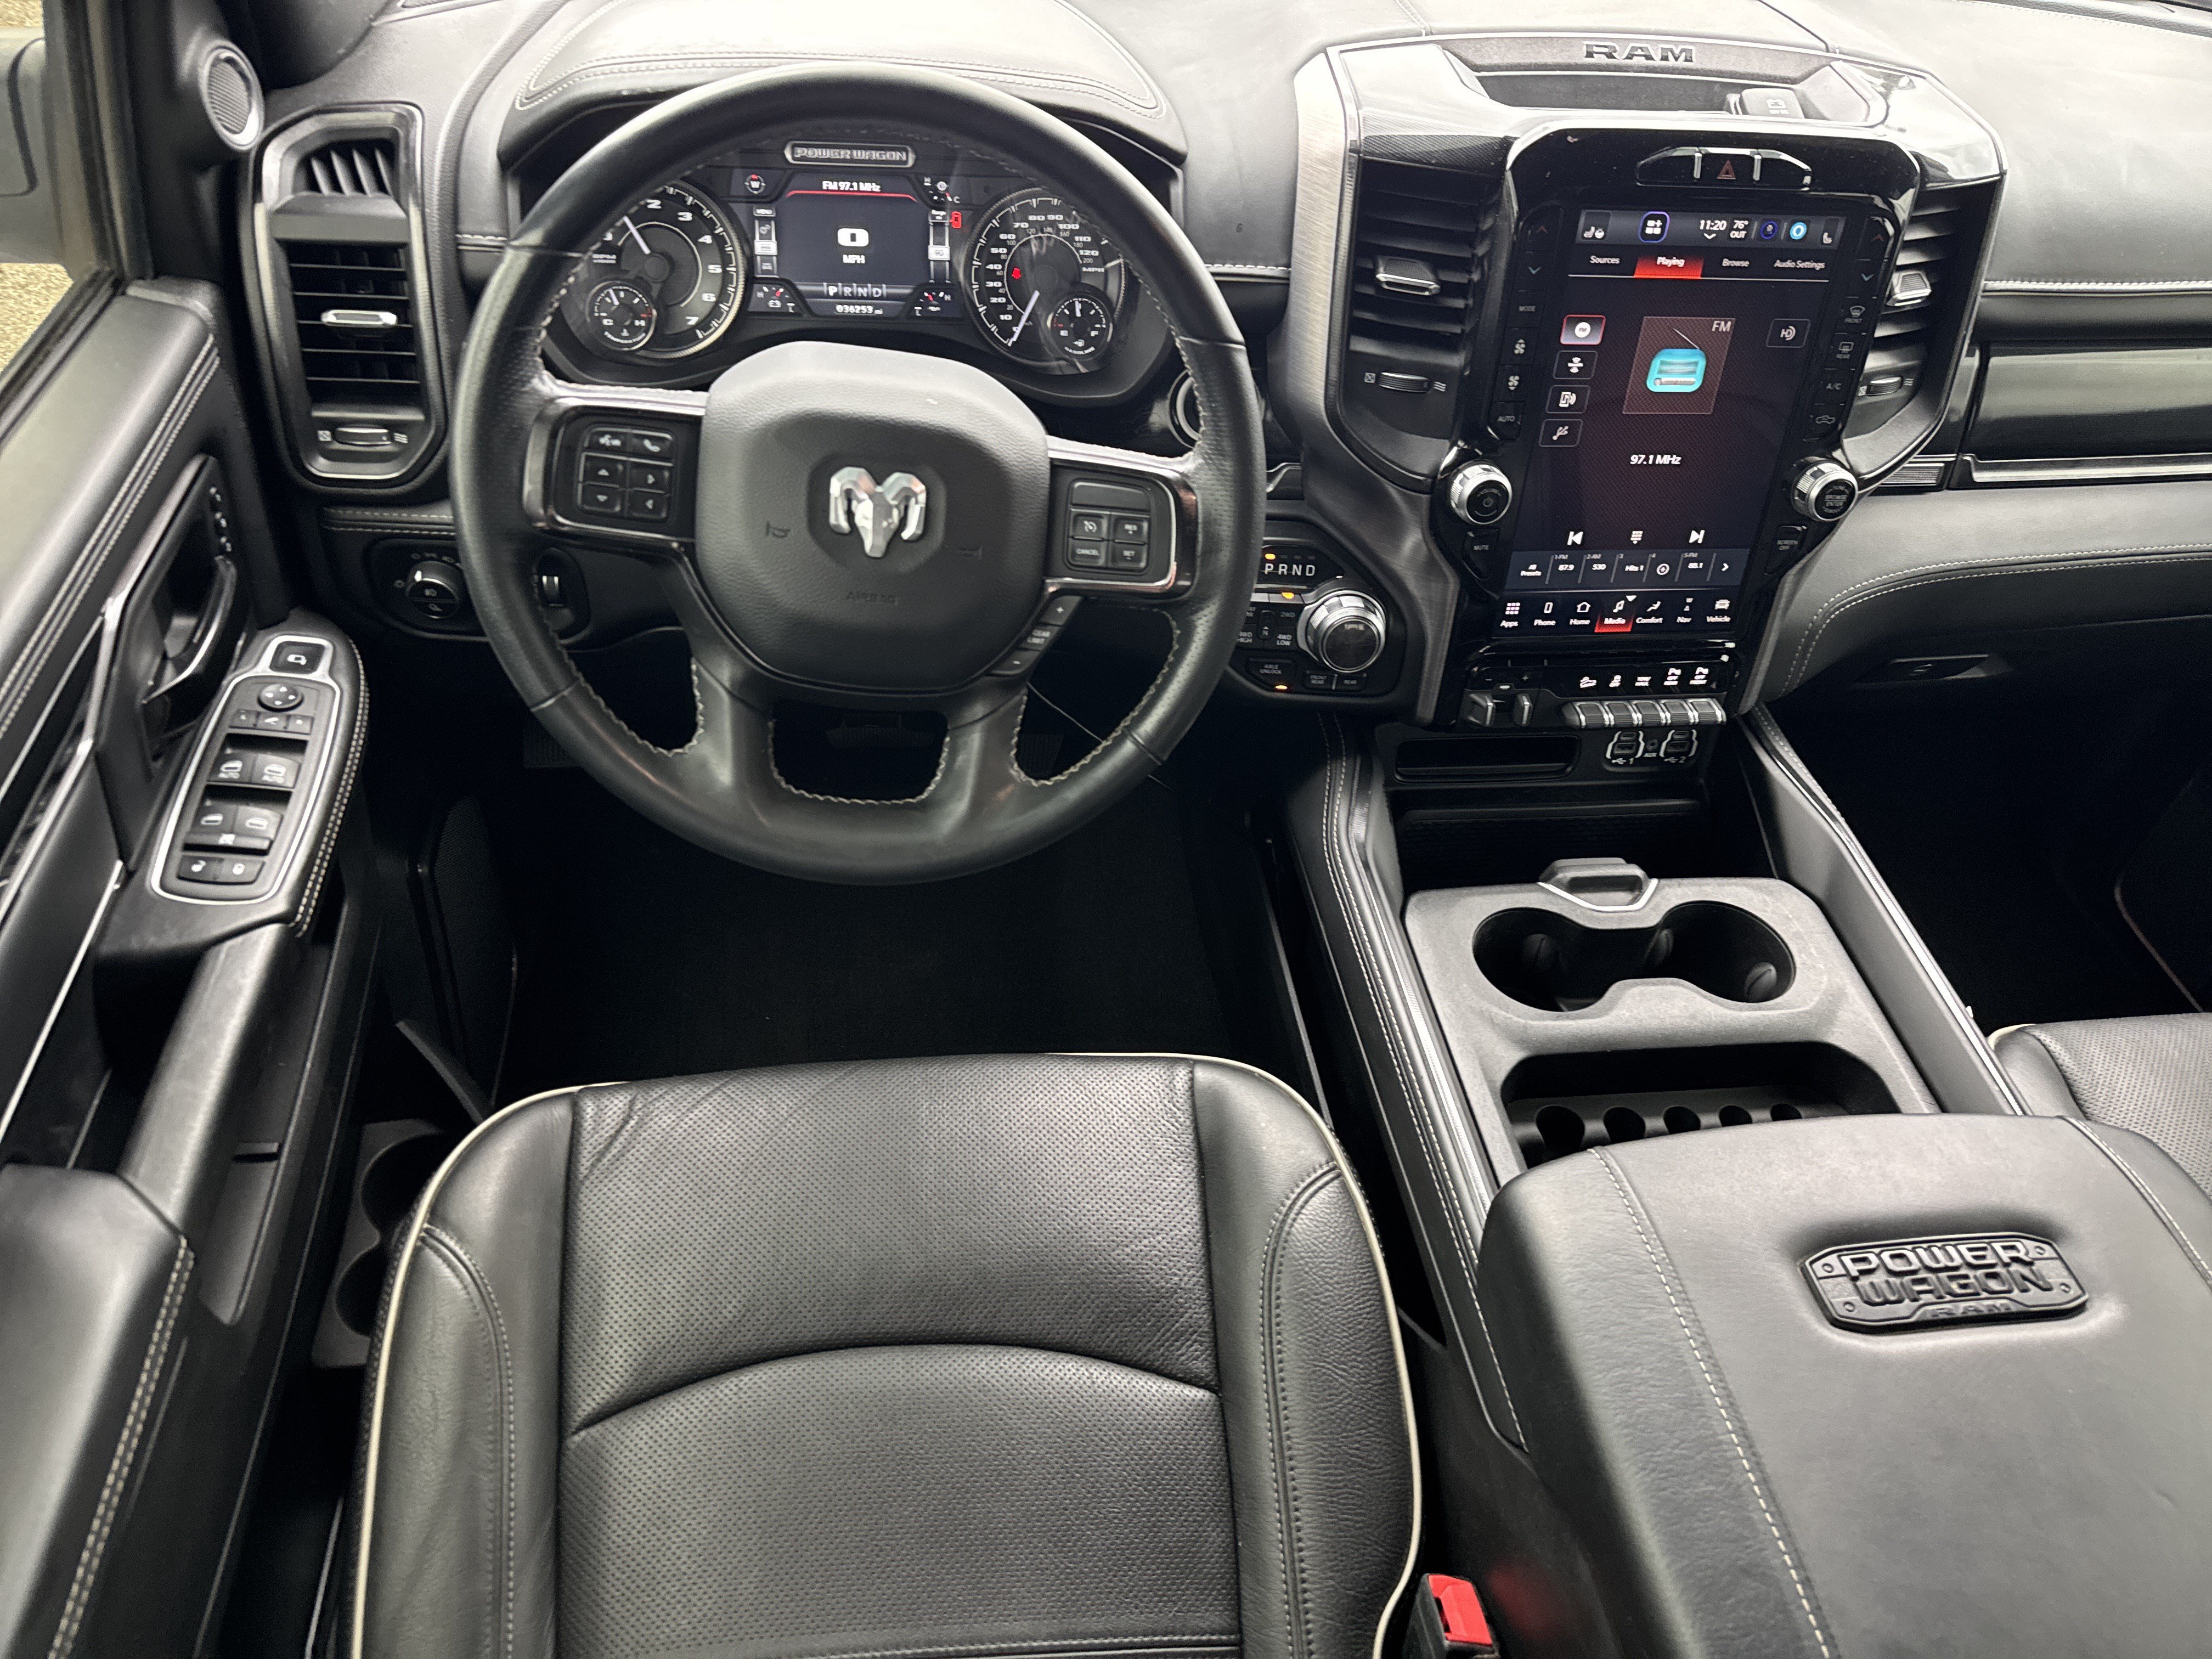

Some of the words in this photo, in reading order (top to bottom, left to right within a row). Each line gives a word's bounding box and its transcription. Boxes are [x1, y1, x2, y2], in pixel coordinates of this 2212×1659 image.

[1583, 41, 1695, 63] RAM
[794, 147, 850, 159] POWER
[853, 149, 906, 161] WAGON
[822, 180, 838, 190] FM
[838, 181, 857, 191] 97.1
[859, 182, 881, 192] MHz
[646, 199, 662, 209] 2
[678, 212, 692, 221] 3
[1700, 219, 1726, 230] 11:20
[1733, 219, 1748, 229] 76°
[698, 235, 712, 244] 4
[838, 228, 869, 247] 0
[843, 254, 865, 264] MPH
[1590, 255, 1620, 264] Sources
[1656, 256, 1685, 267] Playing
[1722, 258, 1750, 267] Browse
[1774, 259, 1796, 268] Audio
[1796, 260, 1825, 270] Settings
[708, 264, 722, 273] 5
[828, 285, 838, 296] P
[844, 286, 852, 297] R
[858, 287, 867, 297] N
[872, 287, 882, 298] D
[701, 293, 716, 302] 6
[836, 304, 873, 314] 036253
[686, 317, 699, 325] 7
[1712, 320, 1731, 332] FM
[1630, 454, 1654, 464] 97.1
[1655, 454, 1681, 464] MHz
[1265, 563, 1274, 575] P
[1278, 563, 1288, 575] R
[1291, 565, 1302, 576] N
[1305, 565, 1316, 576] D
[1838, 1240, 2034, 1281] POWER
[1855, 1267, 2052, 1307] WAGON
[1931, 1300, 2013, 1317] RAM
